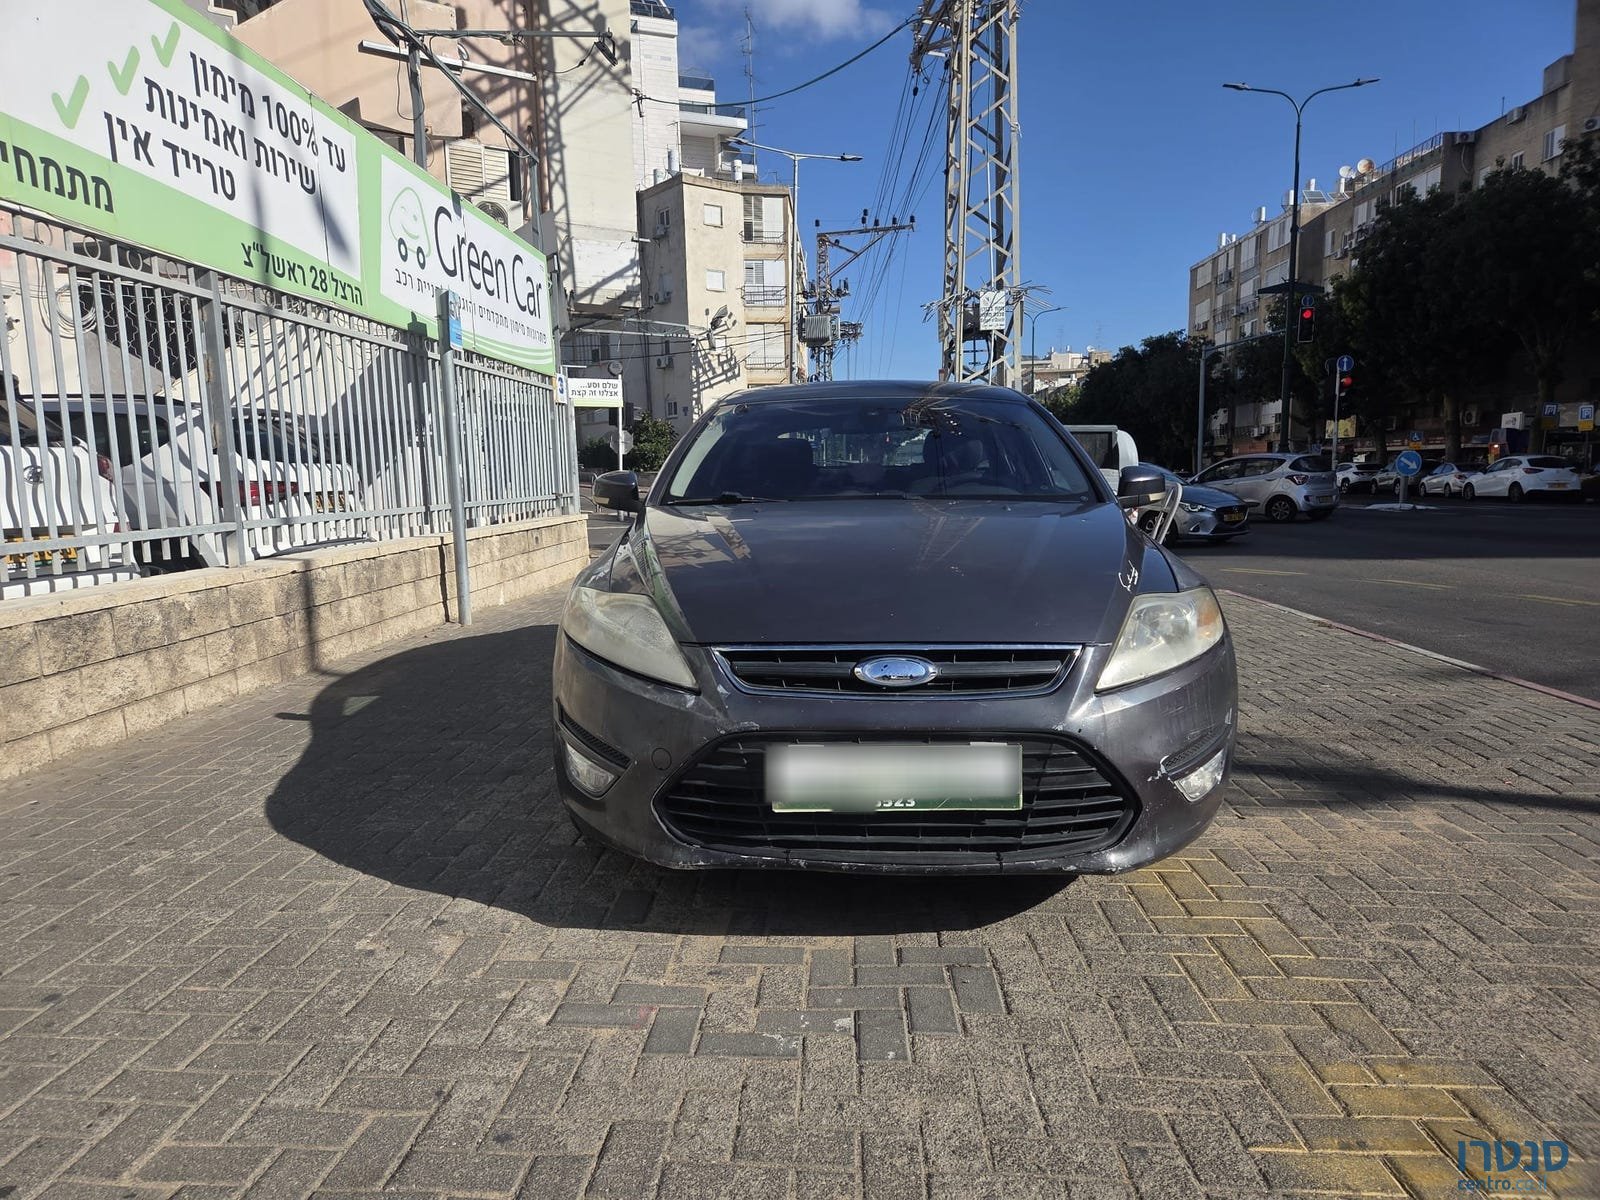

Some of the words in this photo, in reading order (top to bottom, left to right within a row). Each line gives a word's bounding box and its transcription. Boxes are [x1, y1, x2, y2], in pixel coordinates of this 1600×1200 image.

[189, 51, 256, 120] מימון
[143, 76, 248, 161] ואמינות
[262, 95, 319, 157] 100%
[103, 111, 155, 167] אין
[322, 136, 346, 173] עד
[162, 138, 236, 201] טרייד
[253, 136, 316, 195] שירות
[309, 265, 328, 293] 28
[395, 268, 414, 289] רכב
[434, 205, 509, 305] Green
[512, 254, 542, 319] Car
[330, 272, 363, 306] הרצל
[478, 305, 509, 329] מתקדמים
[510, 318, 526, 336] מימון
[571, 389, 587, 398] קצת
[598, 388, 619, 397] אצלנו
[602, 381, 618, 389] שלם
